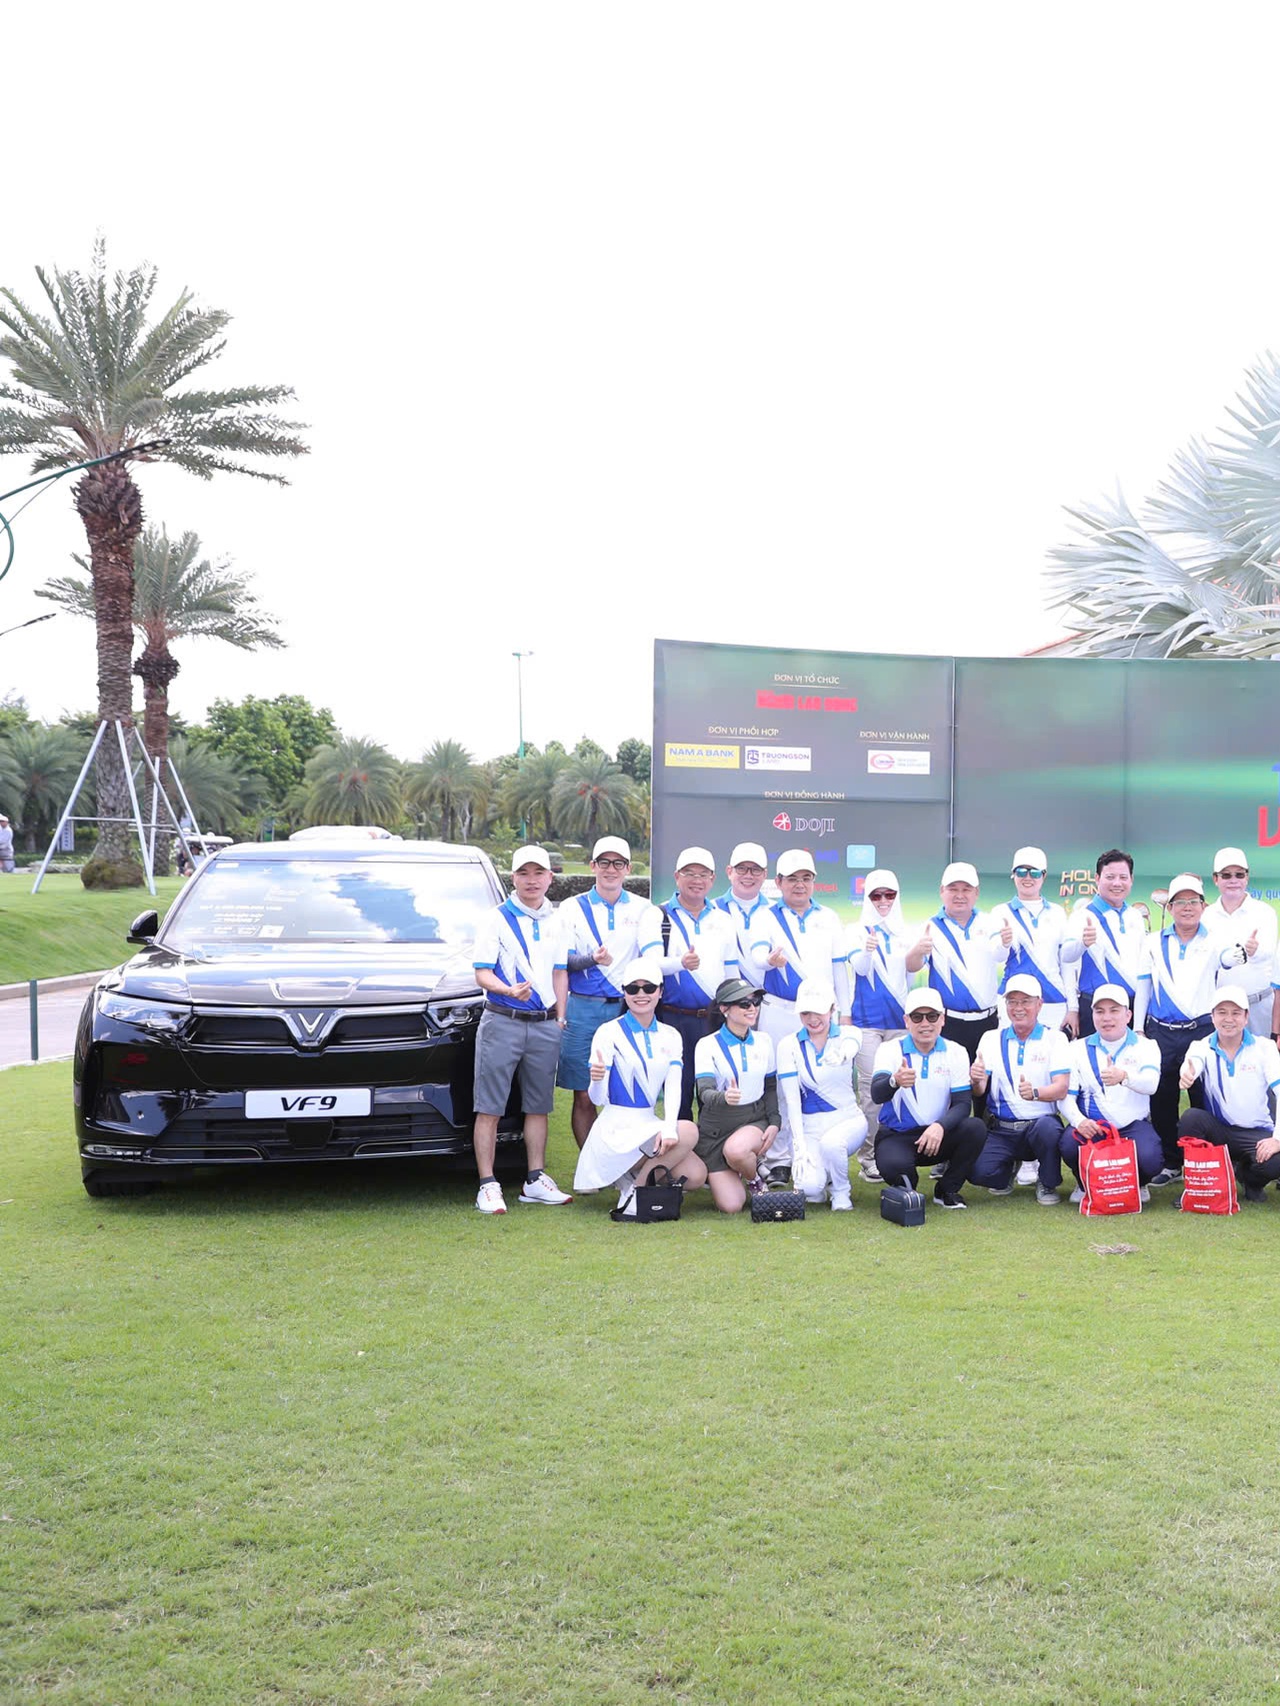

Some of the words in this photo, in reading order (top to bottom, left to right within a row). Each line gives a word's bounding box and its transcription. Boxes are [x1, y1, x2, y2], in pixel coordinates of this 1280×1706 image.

[708, 726, 727, 734] ĐƠN
[669, 748, 695, 756] NAM
[762, 752, 809, 760] TRUONGSON
[795, 817, 835, 837] DOJI
[1061, 870, 1097, 883] HOL
[1060, 884, 1074, 896] IN
[1079, 884, 1099, 895] ON
[281, 1096, 338, 1111] VF9
